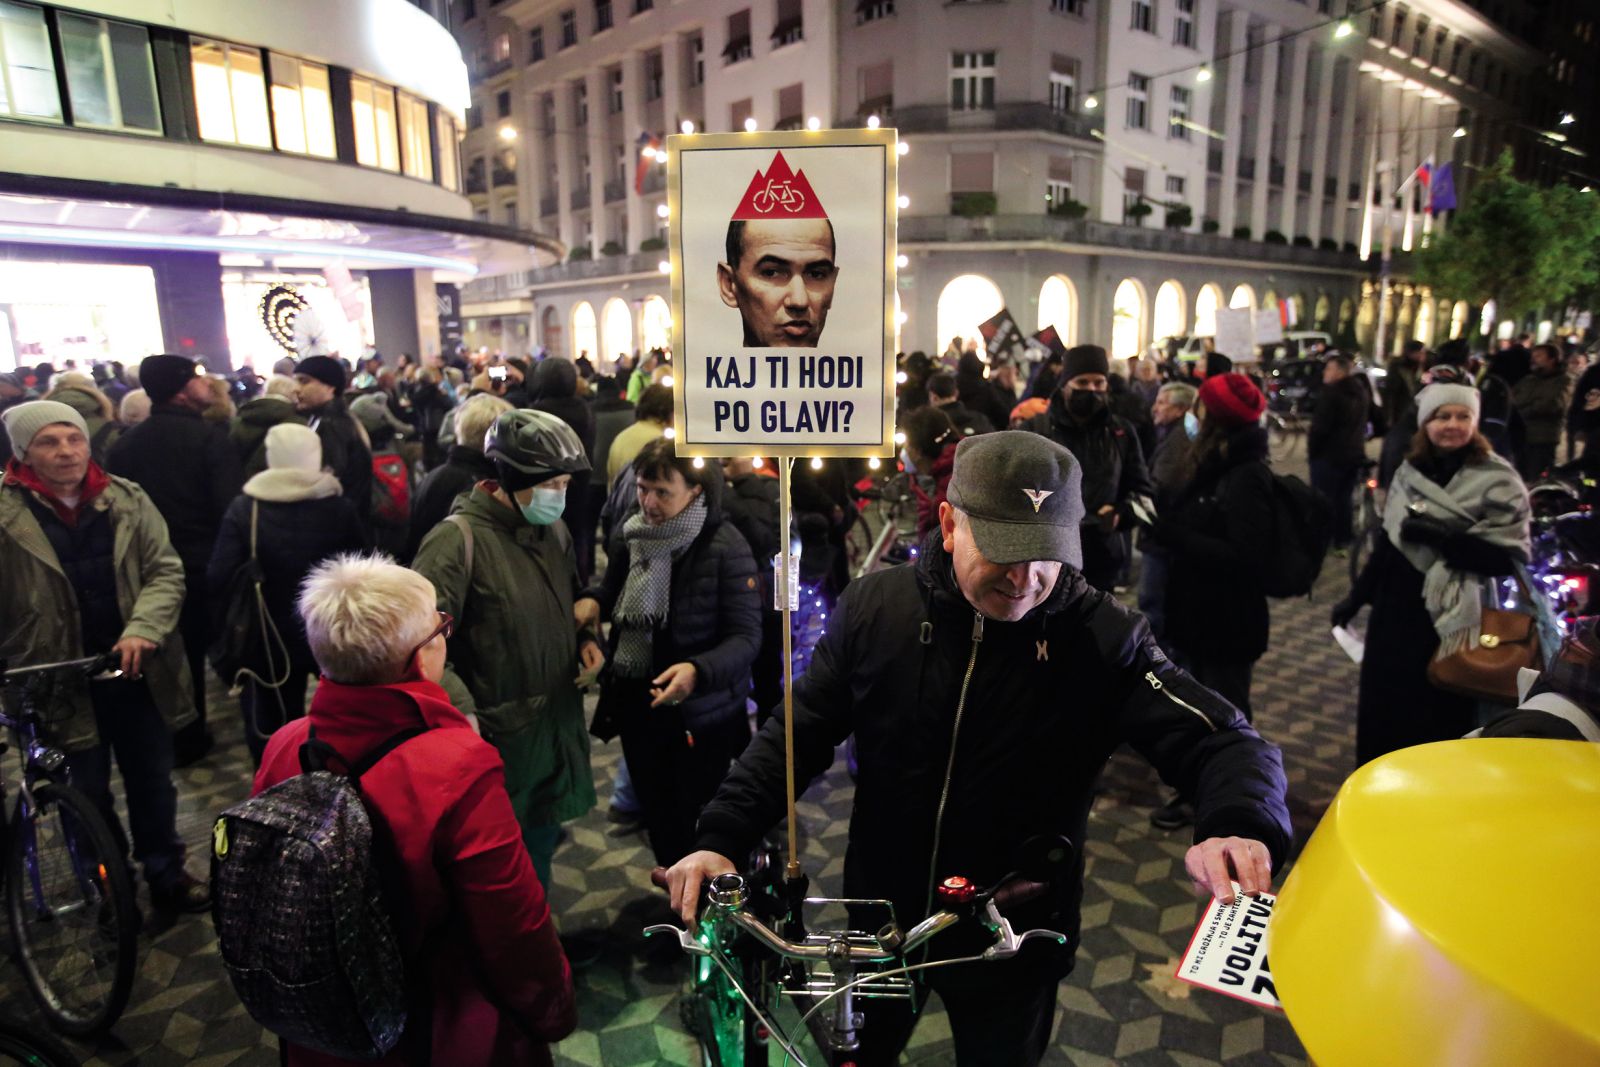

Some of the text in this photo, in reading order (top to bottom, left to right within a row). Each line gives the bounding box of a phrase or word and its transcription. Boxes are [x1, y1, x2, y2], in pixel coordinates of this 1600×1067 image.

[706, 356, 863, 389] KAJ TI HODI
[714, 400, 855, 433] PO GLAVI?
[1227, 895, 1244, 922] ZAHTEVA
[1219, 930, 1229, 939] TO
[1224, 921, 1233, 931] JE
[1218, 894, 1274, 986] VOLITVE
[1190, 965, 1199, 974] TO
